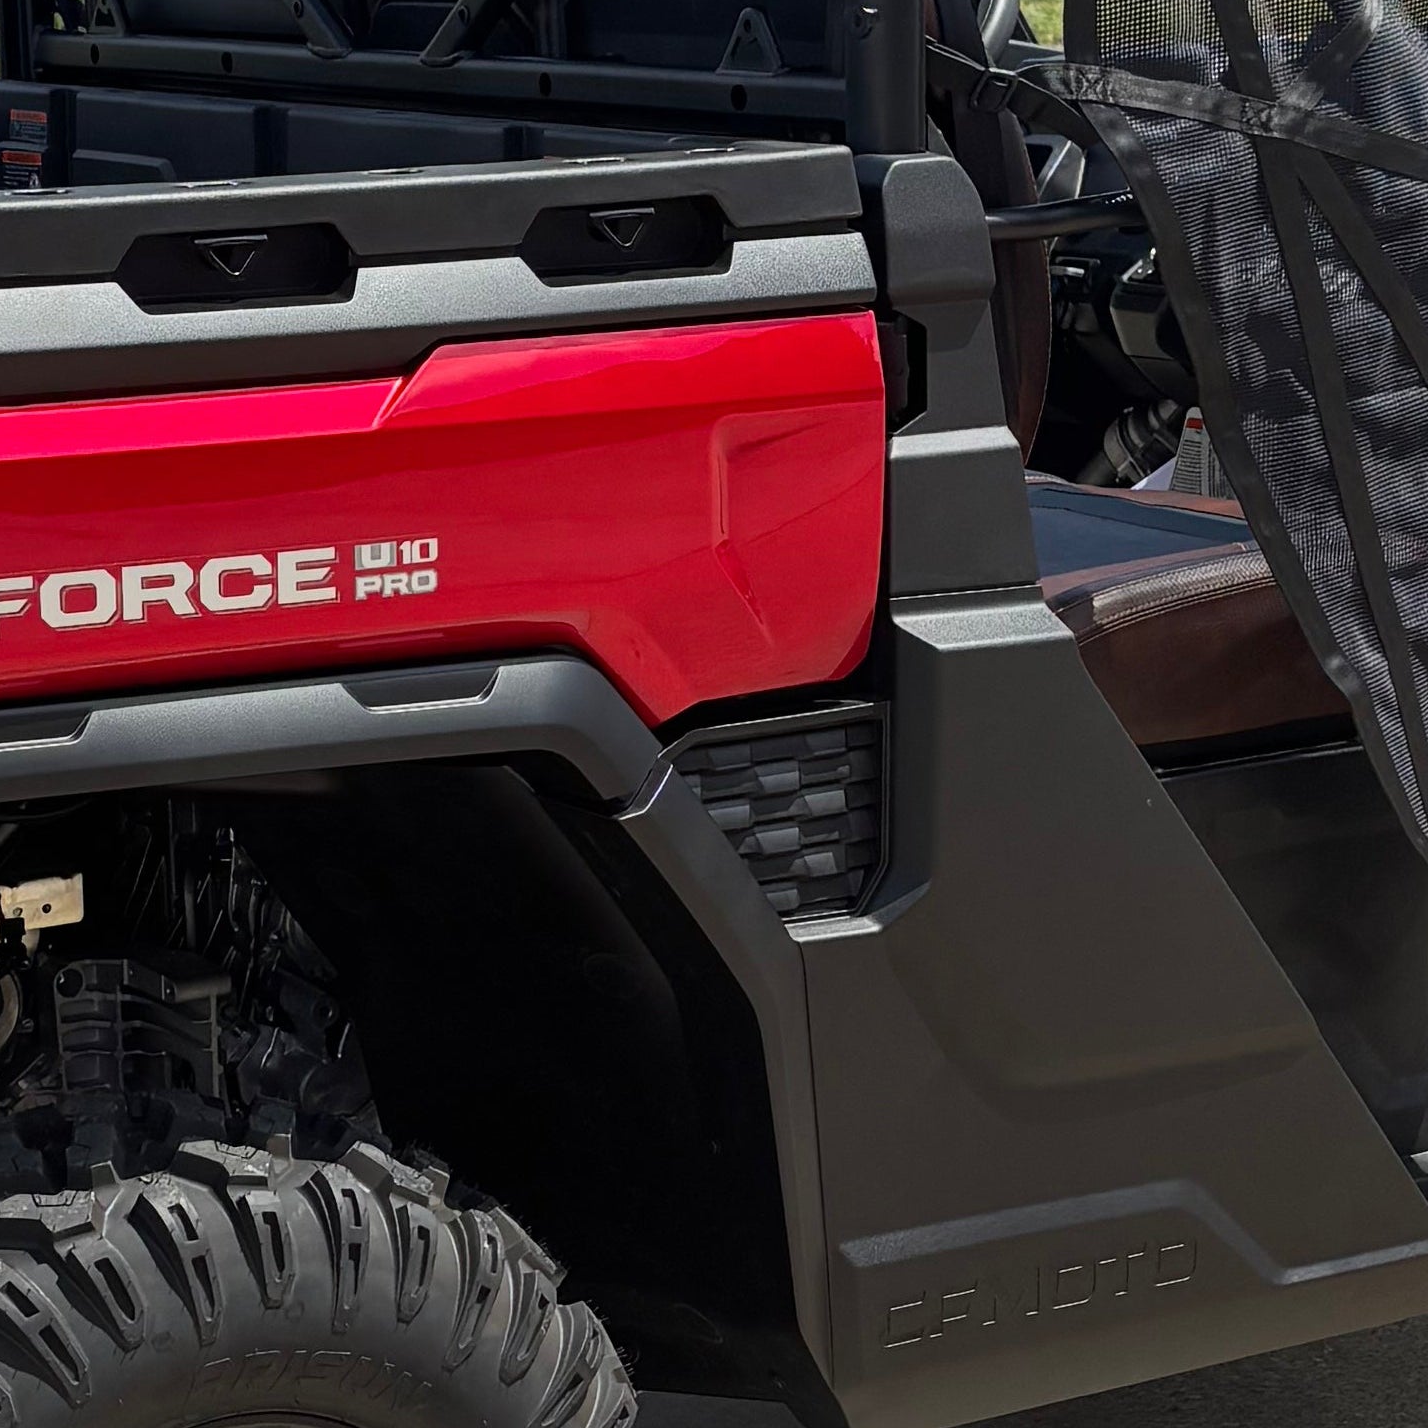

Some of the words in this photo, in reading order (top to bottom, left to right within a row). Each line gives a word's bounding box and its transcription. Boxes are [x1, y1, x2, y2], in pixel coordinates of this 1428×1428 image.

[353, 536, 439, 570] U10
[353, 568, 438, 601] PRO
[882, 1237, 1198, 1349] CFMOTO
